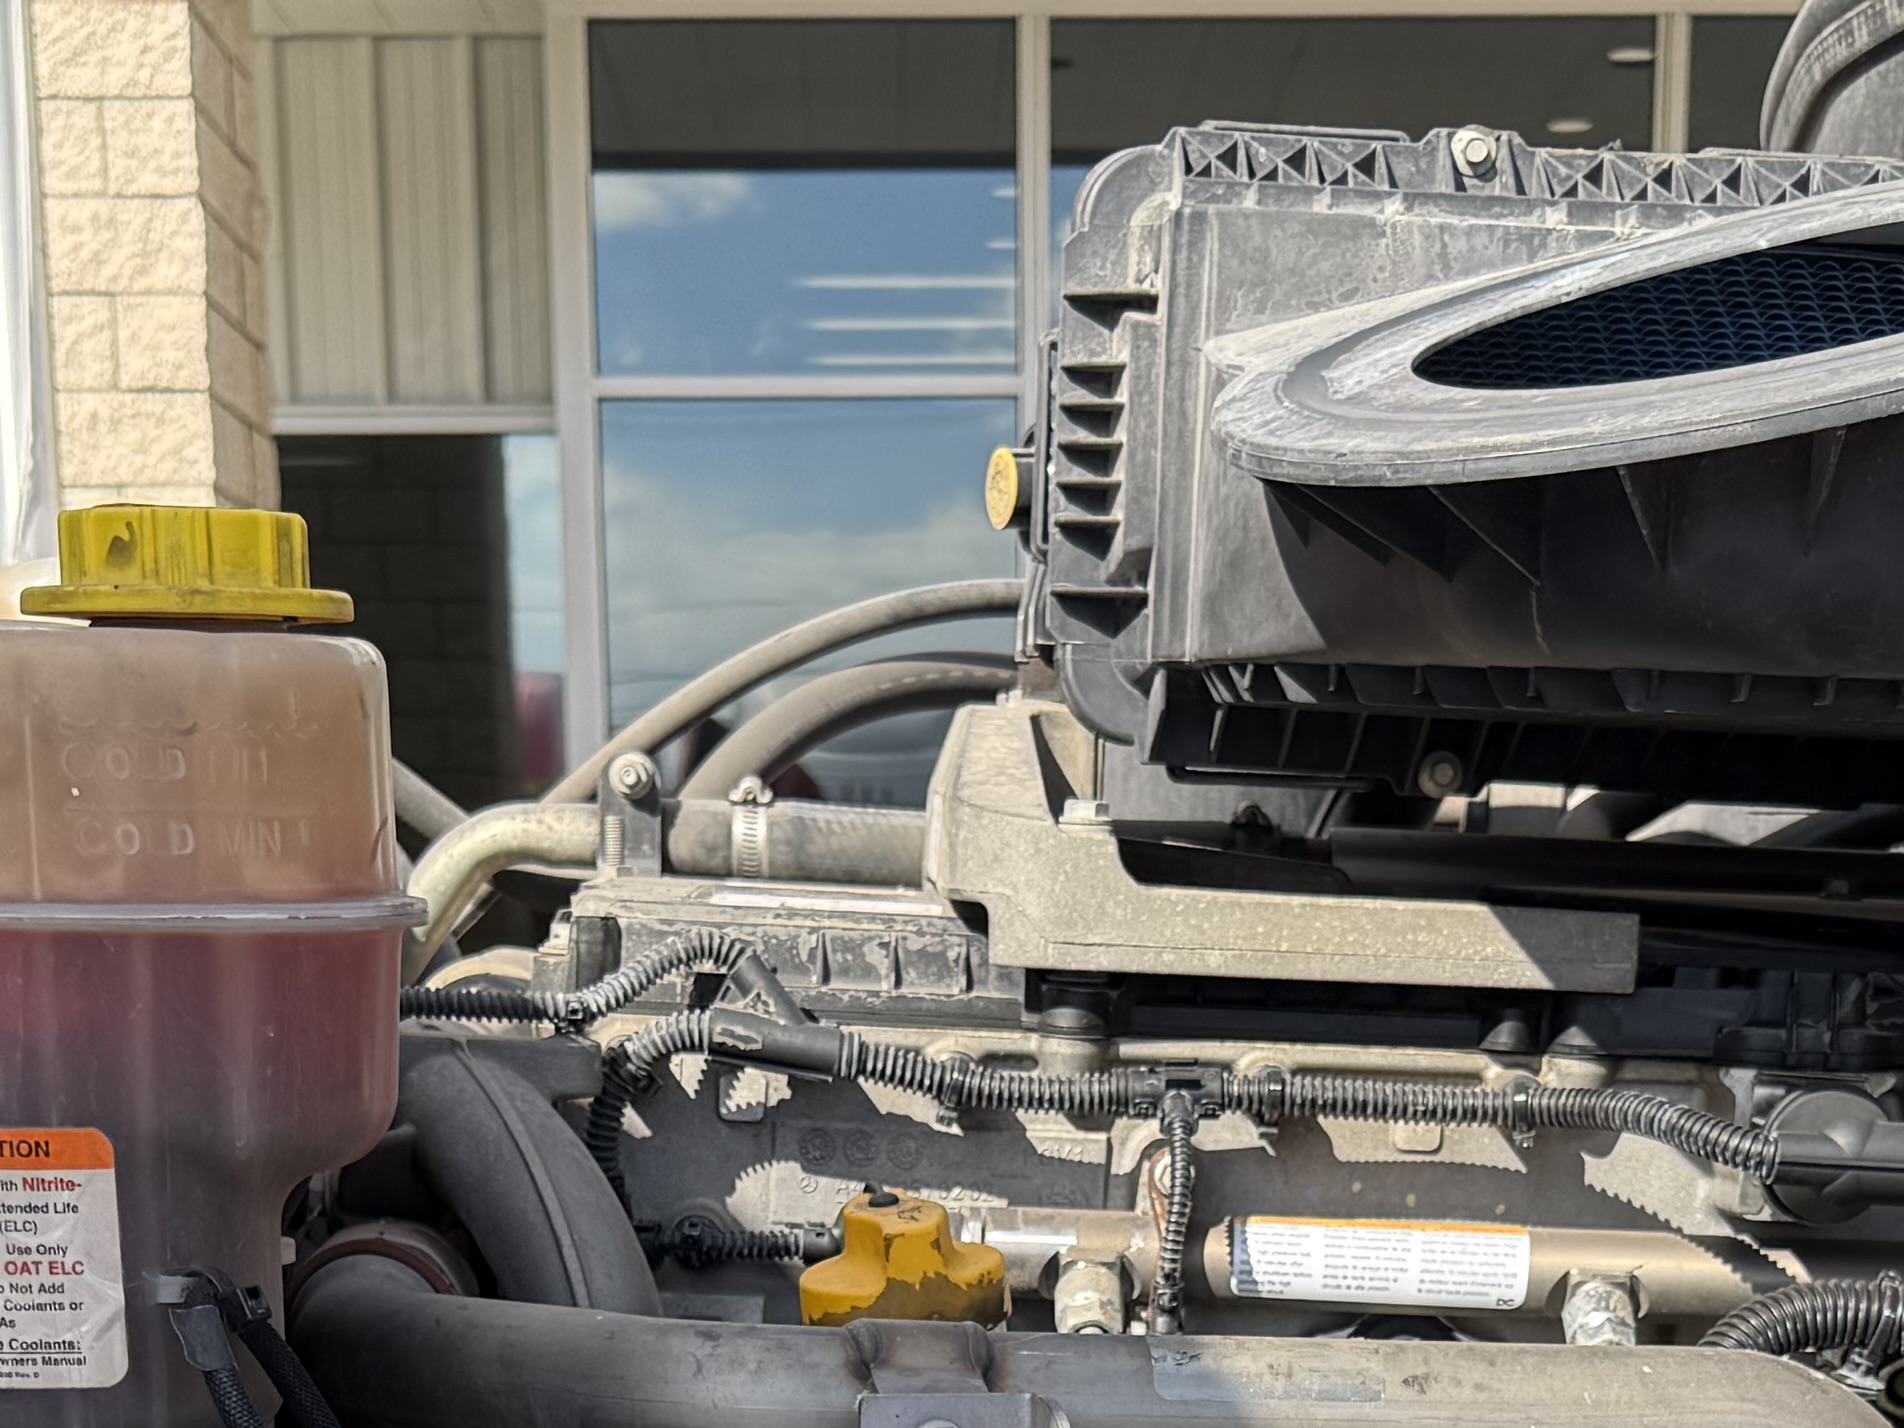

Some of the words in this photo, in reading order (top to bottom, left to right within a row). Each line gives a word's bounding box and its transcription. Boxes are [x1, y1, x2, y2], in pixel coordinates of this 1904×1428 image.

[22, 1177, 82, 1192] Nitrite-
[53, 1201, 79, 1215] Life
[6, 1243, 33, 1256] Use
[35, 1243, 68, 1258] Only
[4, 1260, 43, 1275] OAT
[48, 1260, 85, 1276] ELC
[9, 1282, 33, 1294] Not
[38, 1282, 65, 1294] Add
[3, 1300, 65, 1312] Coolants
[69, 1302, 84, 1311] or
[8, 1338, 81, 1352] Coolants:
[42, 1356, 86, 1366] Manual
